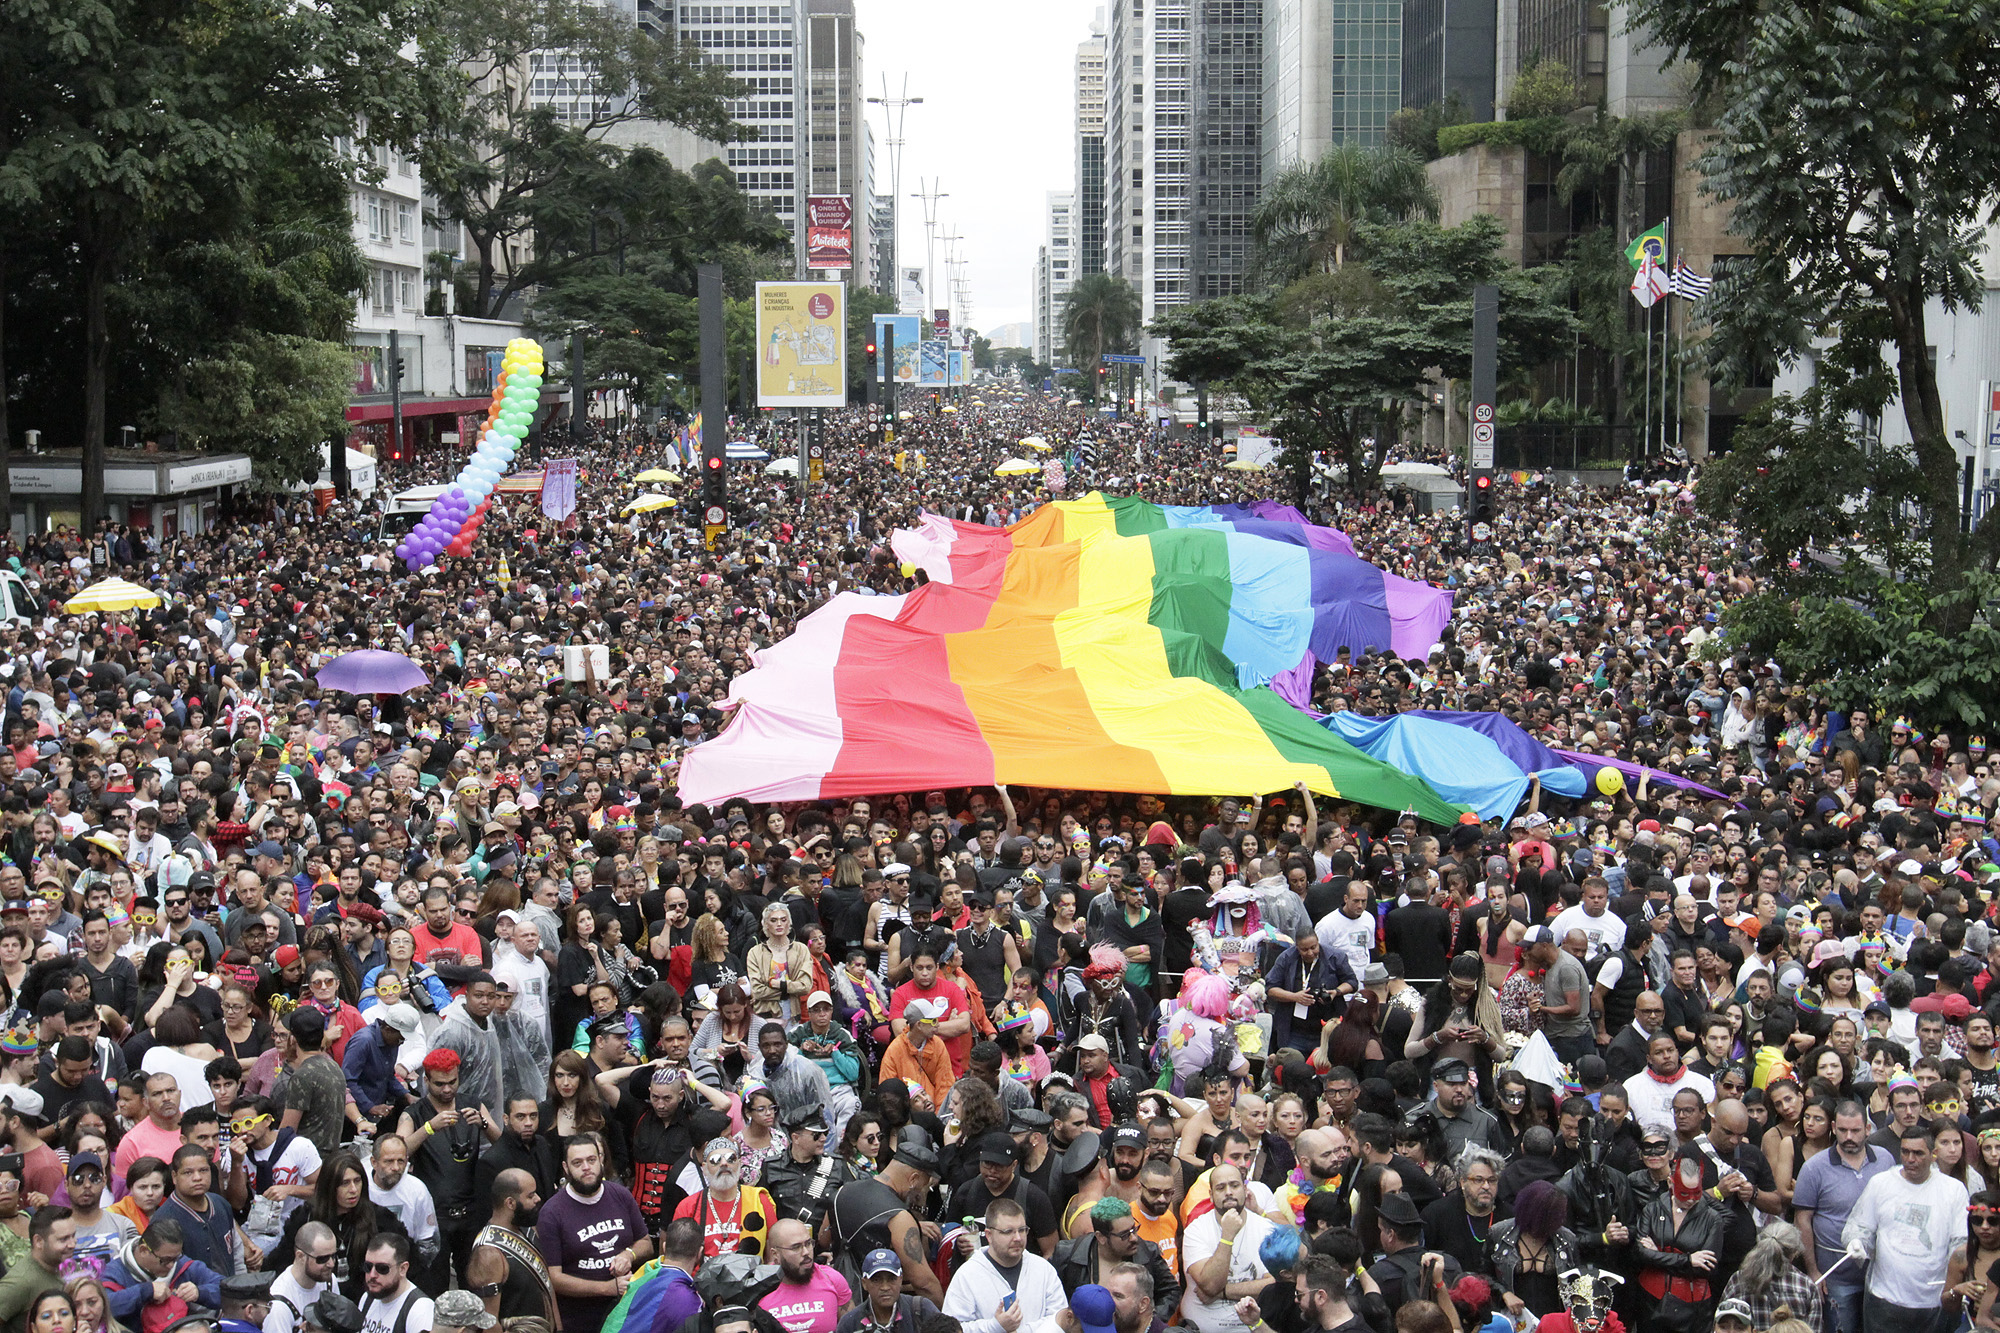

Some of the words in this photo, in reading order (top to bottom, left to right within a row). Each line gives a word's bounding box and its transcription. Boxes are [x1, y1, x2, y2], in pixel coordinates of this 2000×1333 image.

[1478, 408, 1491, 417] 50
[579, 660, 602, 669] zotis
[1117, 1128, 1140, 1138] SWAT
[576, 1218, 625, 1243] EAGLE
[704, 1222, 741, 1236] EAGL
[504, 1233, 536, 1264] MISTER
[578, 1257, 604, 1269] SÃO
[768, 1300, 825, 1319] EAGLE
